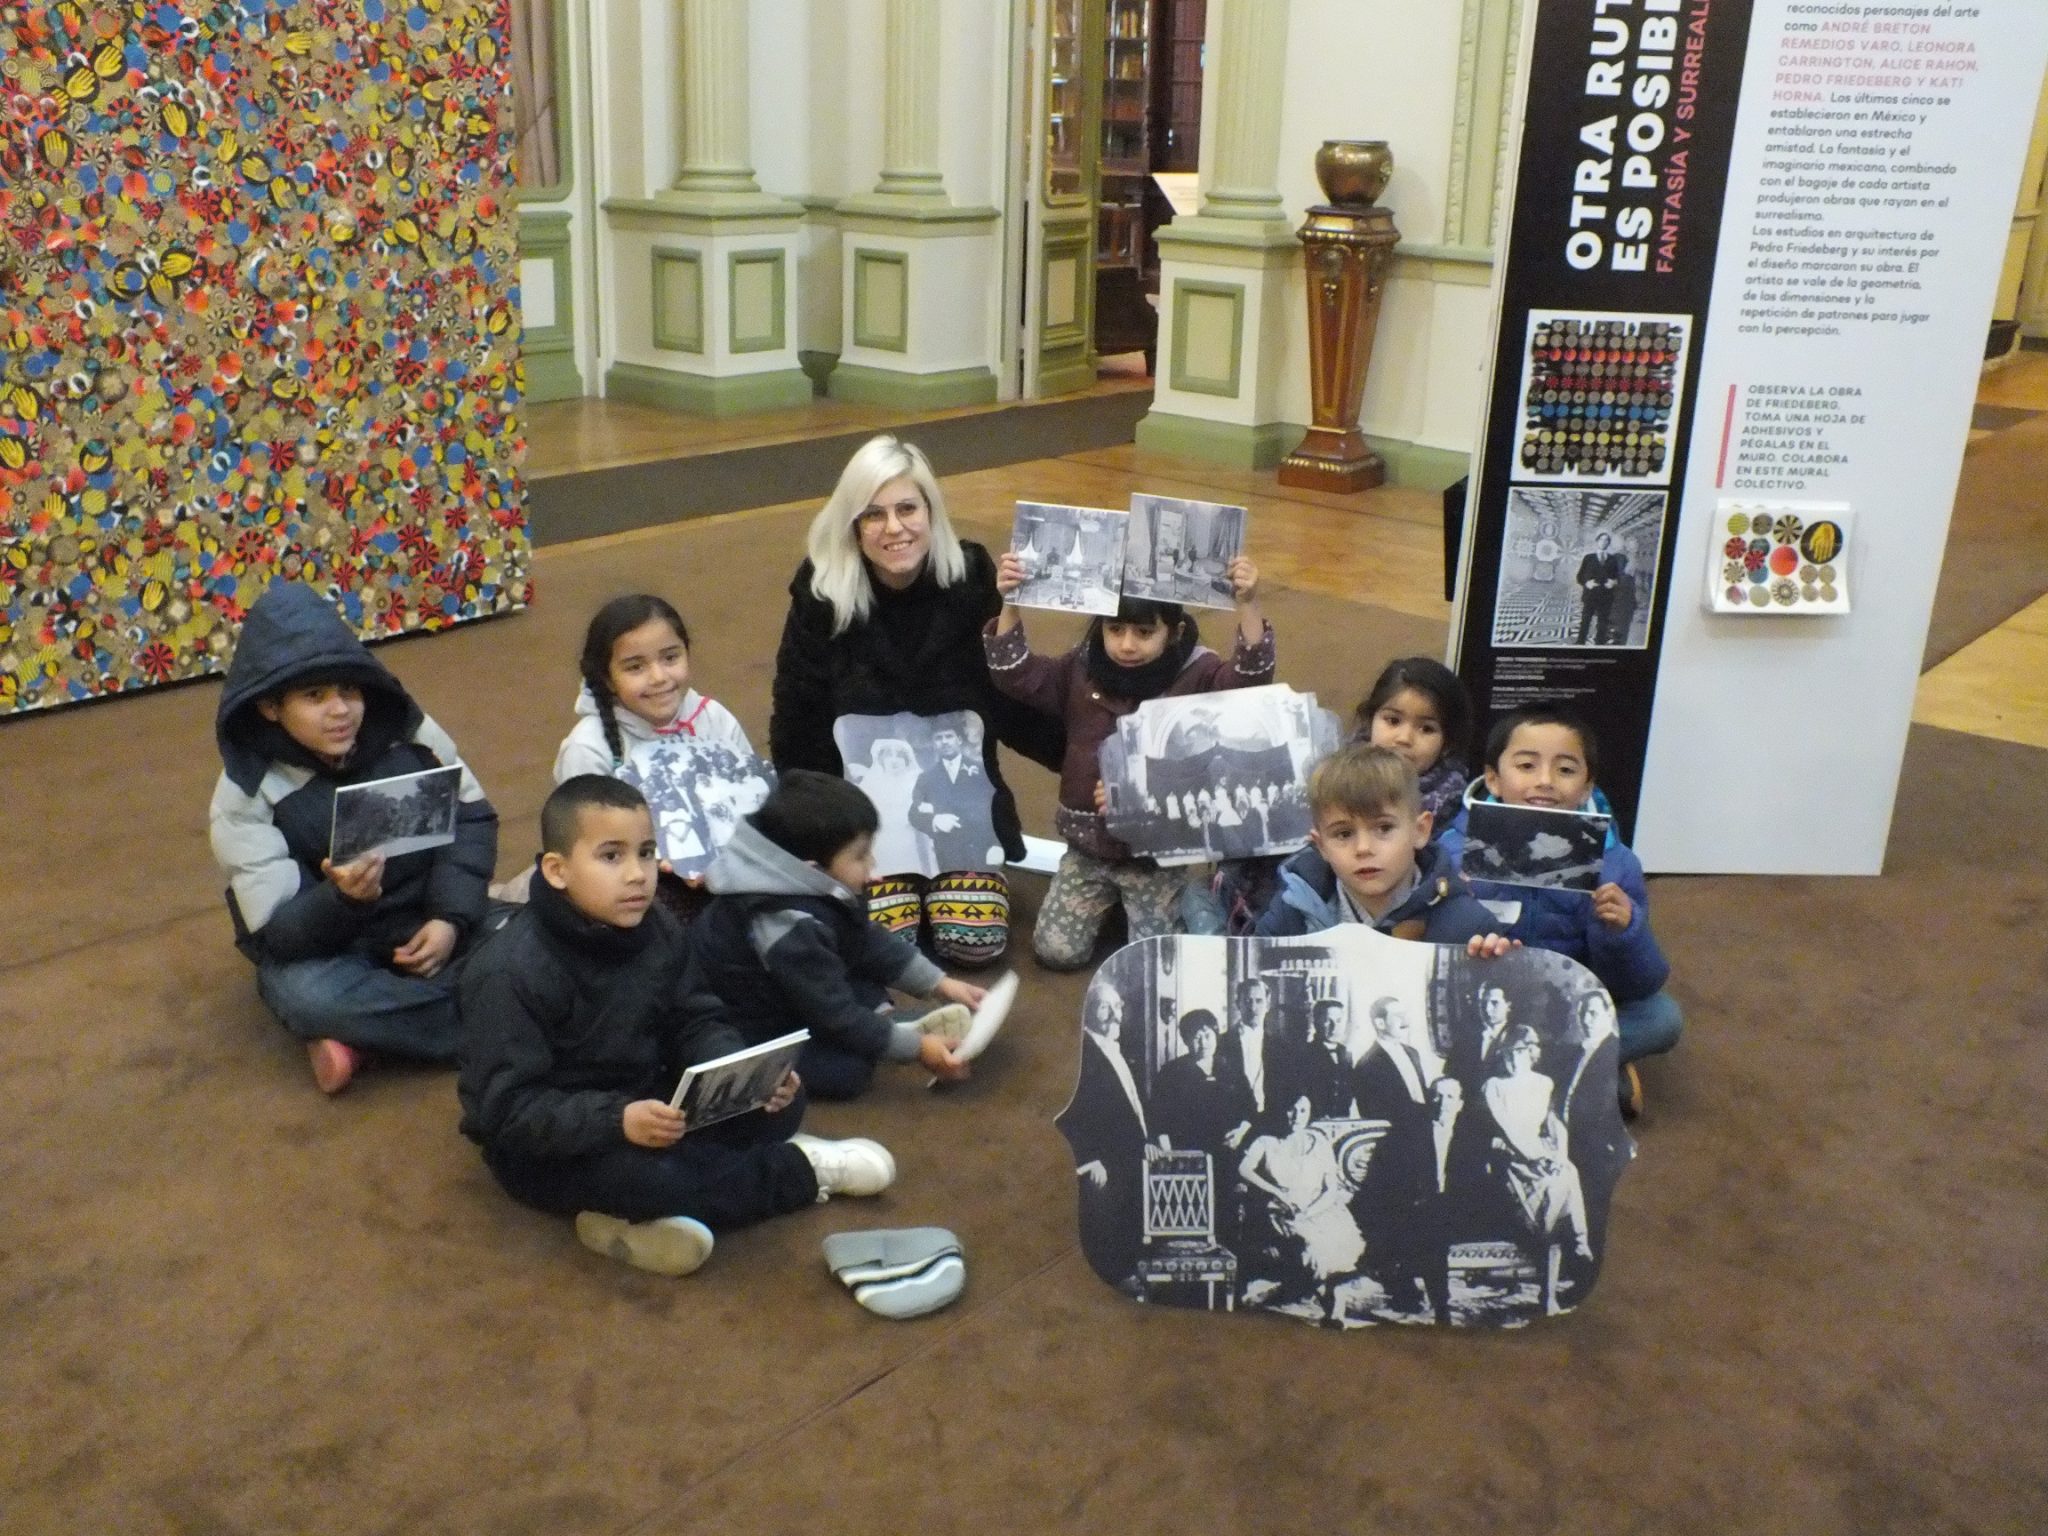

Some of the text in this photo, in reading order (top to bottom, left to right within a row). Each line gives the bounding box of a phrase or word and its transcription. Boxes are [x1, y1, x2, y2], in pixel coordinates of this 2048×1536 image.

[1787, 4, 1979, 18] reconocidos personajes del arte
[1785, 22, 1817, 31] como
[1821, 19, 1869, 33] ANDRÉ
[1781, 38, 1854, 49] REMEDIOS
[1909, 42, 1975, 52] LEONORA
[1880, 59, 1921, 70] ALICE
[1776, 73, 1822, 84] PEDRO
[1826, 75, 1912, 87] FRIEDEBERG
[1916, 77, 1925, 86] Y
[1830, 93, 1851, 103] Los
[1902, 94, 1933, 105] cinco
[1937, 97, 1951, 105] se
[1770, 109, 1851, 120] establecieron
[1919, 114, 1926, 125] y
[1656, 0, 1710, 272] FANTASÍA Y SURREAL
[1768, 126, 1912, 139] entablaron una estrecha
[1820, 143, 1833, 154] La
[1890, 147, 1896, 157] y
[1900, 145, 1910, 156] el
[1762, 160, 1825, 172] imaginario
[1891, 163, 1957, 174] combinado
[1760, 177, 1930, 191] con el bagaje de cada artista
[1566, 115, 1618, 270] OTRA
[1757, 193, 1949, 208] produjeron obras que rayan en el
[1611, 207, 1653, 271] ES
[1753, 226, 1934, 241] Los estudios en arquitectura de
[1750, 242, 1783, 253] Pedro
[1786, 243, 1848, 257] Friedeberg
[1851, 247, 1858, 257] y
[1878, 246, 1917, 256] interés
[1920, 249, 1939, 258] por
[1748, 258, 1758, 268] el
[1761, 258, 1798, 269] diseño
[1802, 261, 1856, 271] marcaron
[1860, 264, 1873, 272] su
[1908, 262, 1919, 273] El
[1745, 275, 1783, 285] artista
[1803, 276, 1826, 286] vale
[1830, 277, 1844, 287] de
[1847, 277, 1857, 288] la
[1743, 291, 1875, 306] de las dimensiones y la
[1740, 306, 1930, 324] repetición de patrones para jugar
[1738, 325, 1759, 333] con
[1763, 324, 1772, 334] la
[1749, 385, 1862, 396] OBSERVA LA OBRA
[1746, 398, 1762, 408] DE
[1745, 412, 1866, 424] TOMA UNA HOJA DE
[1743, 426, 1823, 436] ADHESIVOS Y
[1741, 438, 1829, 450] PÉGALAS EN EL
[1782, 453, 1849, 464] COLABORA
[1737, 466, 1830, 476] EN ESTE MURAL
